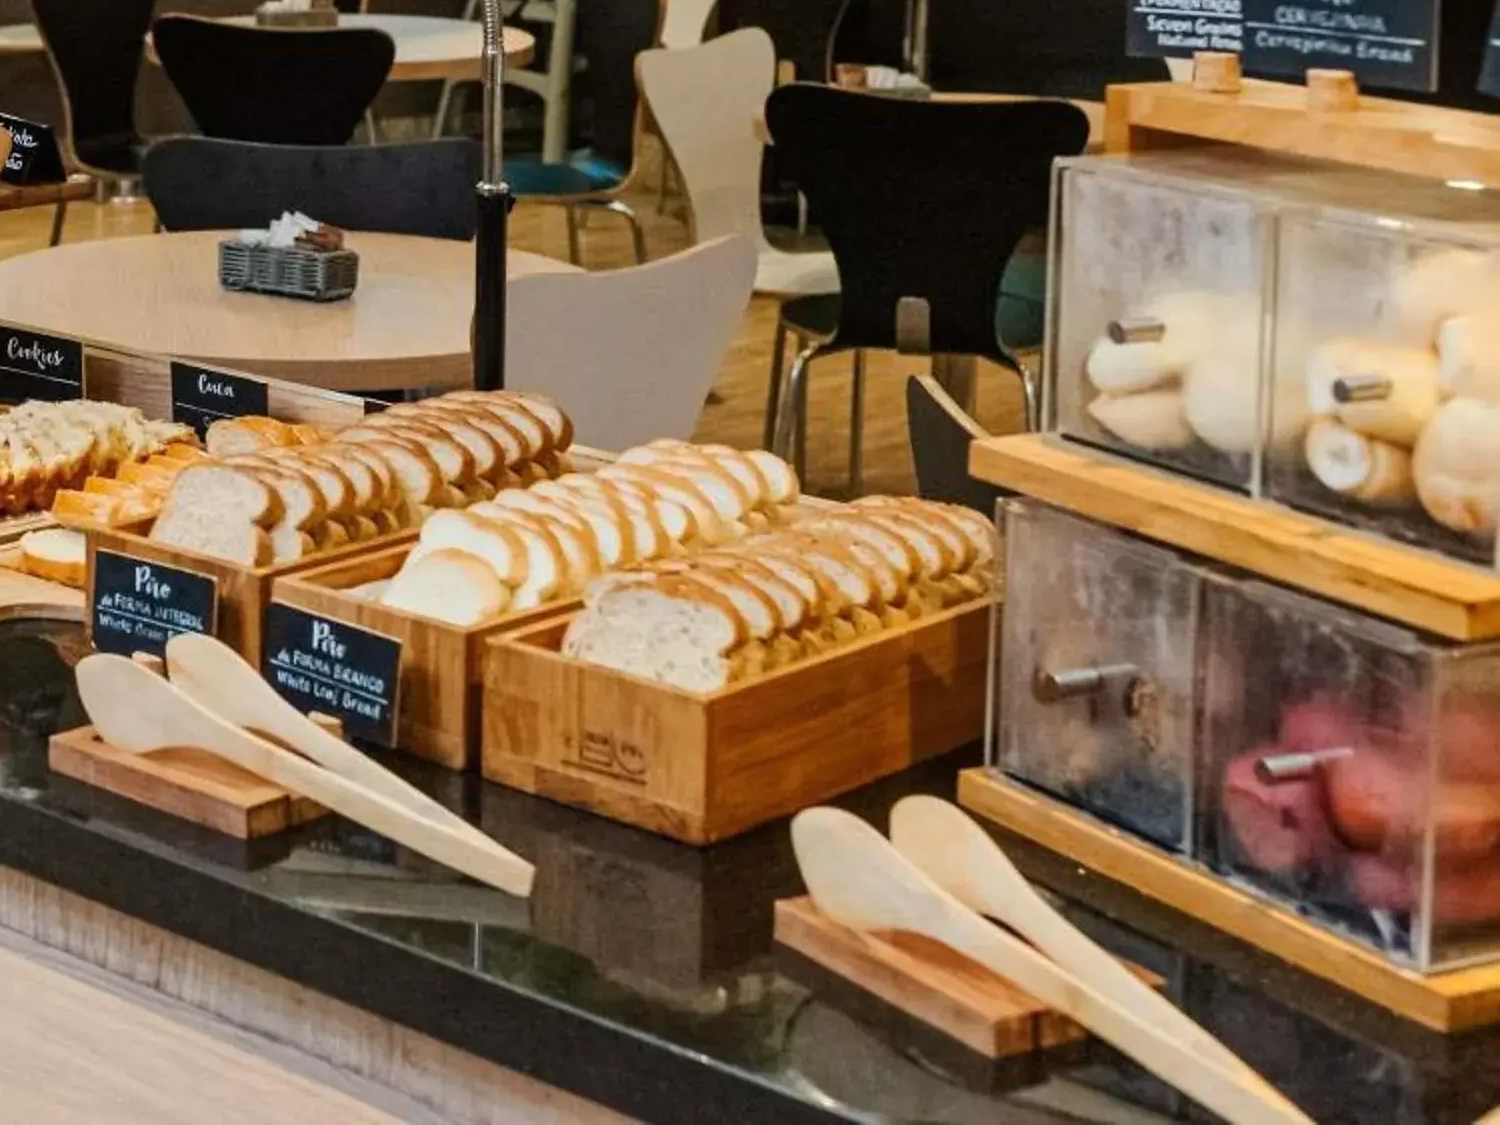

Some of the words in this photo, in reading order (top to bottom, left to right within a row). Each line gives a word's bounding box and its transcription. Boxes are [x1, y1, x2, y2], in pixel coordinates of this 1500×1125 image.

[7, 336, 65, 370] Cookies
[134, 565, 171, 599] Pão
[312, 620, 346, 659] Pão
